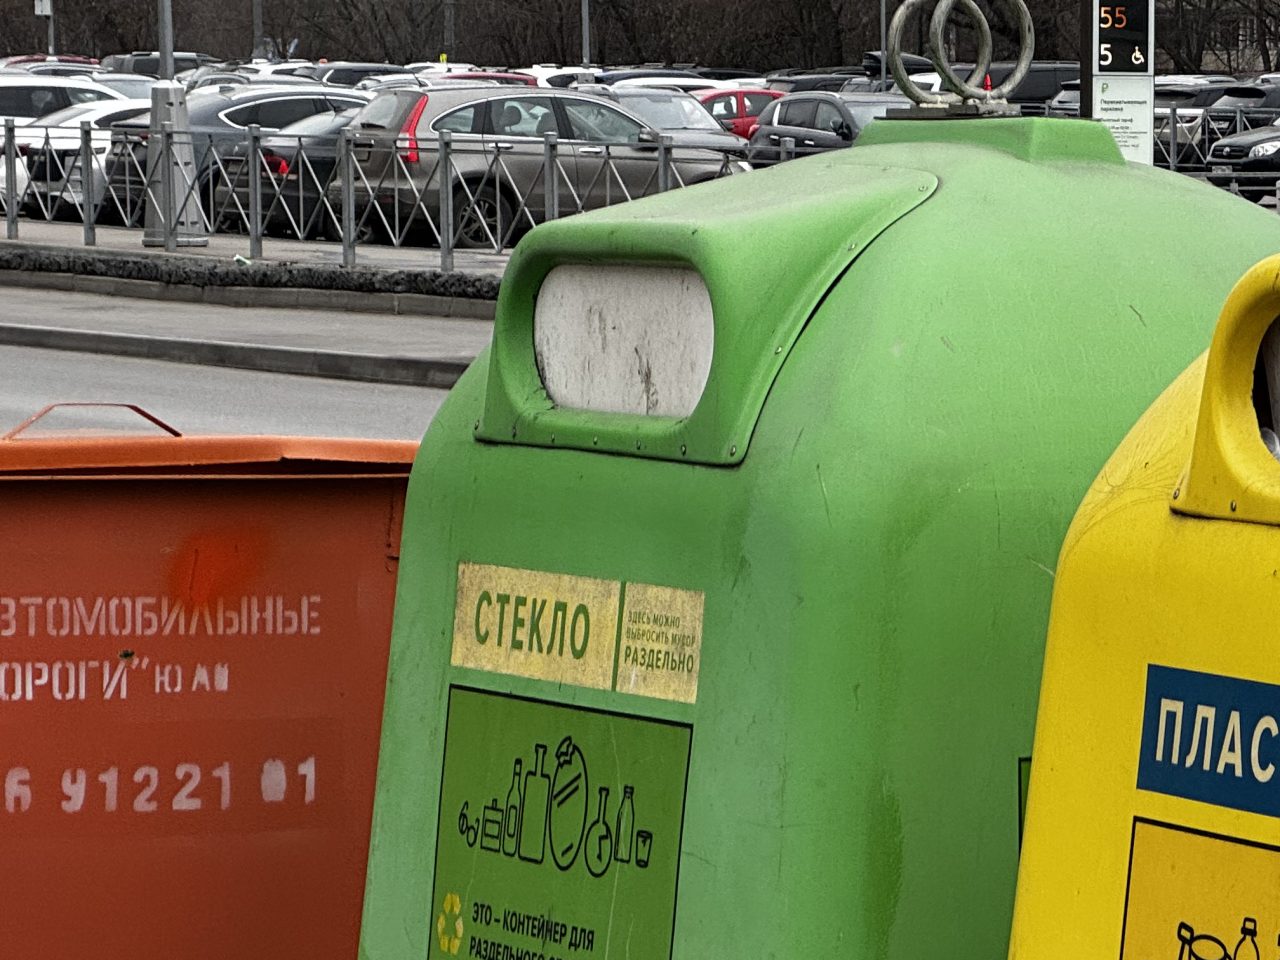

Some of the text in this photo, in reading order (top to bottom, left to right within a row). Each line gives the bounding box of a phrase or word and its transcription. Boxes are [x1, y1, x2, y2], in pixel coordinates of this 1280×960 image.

[1100, 44, 1112, 66] 5
[475, 590, 590, 660] СТЕКЛО
[628, 610, 680, 629] ЗДЕСЬ МОЖНО
[626, 627, 696, 648] ВЫБРОСИТЬ МУСОР
[625, 646, 694, 673] РАЗДЕЛЬНО
[472, 902, 493, 926] ЭТО
[503, 909, 567, 944] КОНТЕЙНЕР
[568, 926, 595, 952] ДЛЯ
